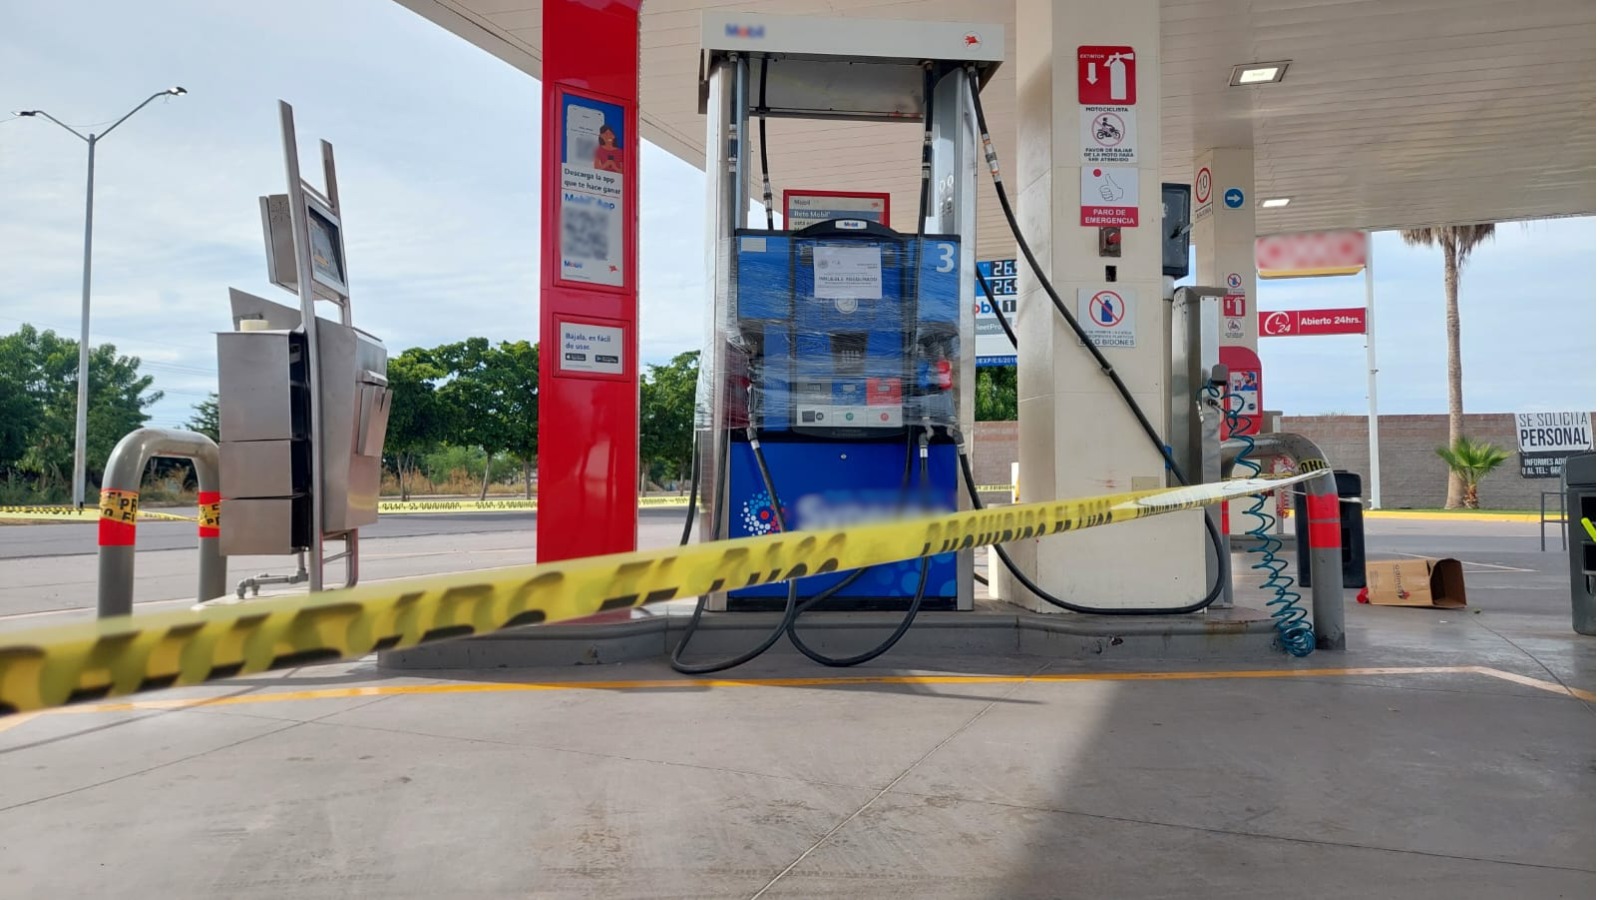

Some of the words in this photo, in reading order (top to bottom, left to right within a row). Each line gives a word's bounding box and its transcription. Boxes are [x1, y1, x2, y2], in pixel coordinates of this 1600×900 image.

[564, 168, 594, 180] Descarga
[603, 176, 616, 184] app
[564, 180, 577, 188] que
[586, 182, 602, 190] hace
[603, 187, 621, 195] ganar
[1093, 208, 1115, 216] PARO
[1085, 216, 1135, 225] EMERGENCIA
[936, 243, 955, 274] 3
[1300, 316, 1332, 326] Abierto
[1334, 315, 1362, 325] 24hrs.
[1519, 413, 1534, 427] SE
[1537, 411, 1588, 427] SOLICITA
[1521, 427, 1590, 446] PERSONAL
[1524, 458, 1554, 466] INFORMES
[1535, 466, 1548, 475] TEL:
